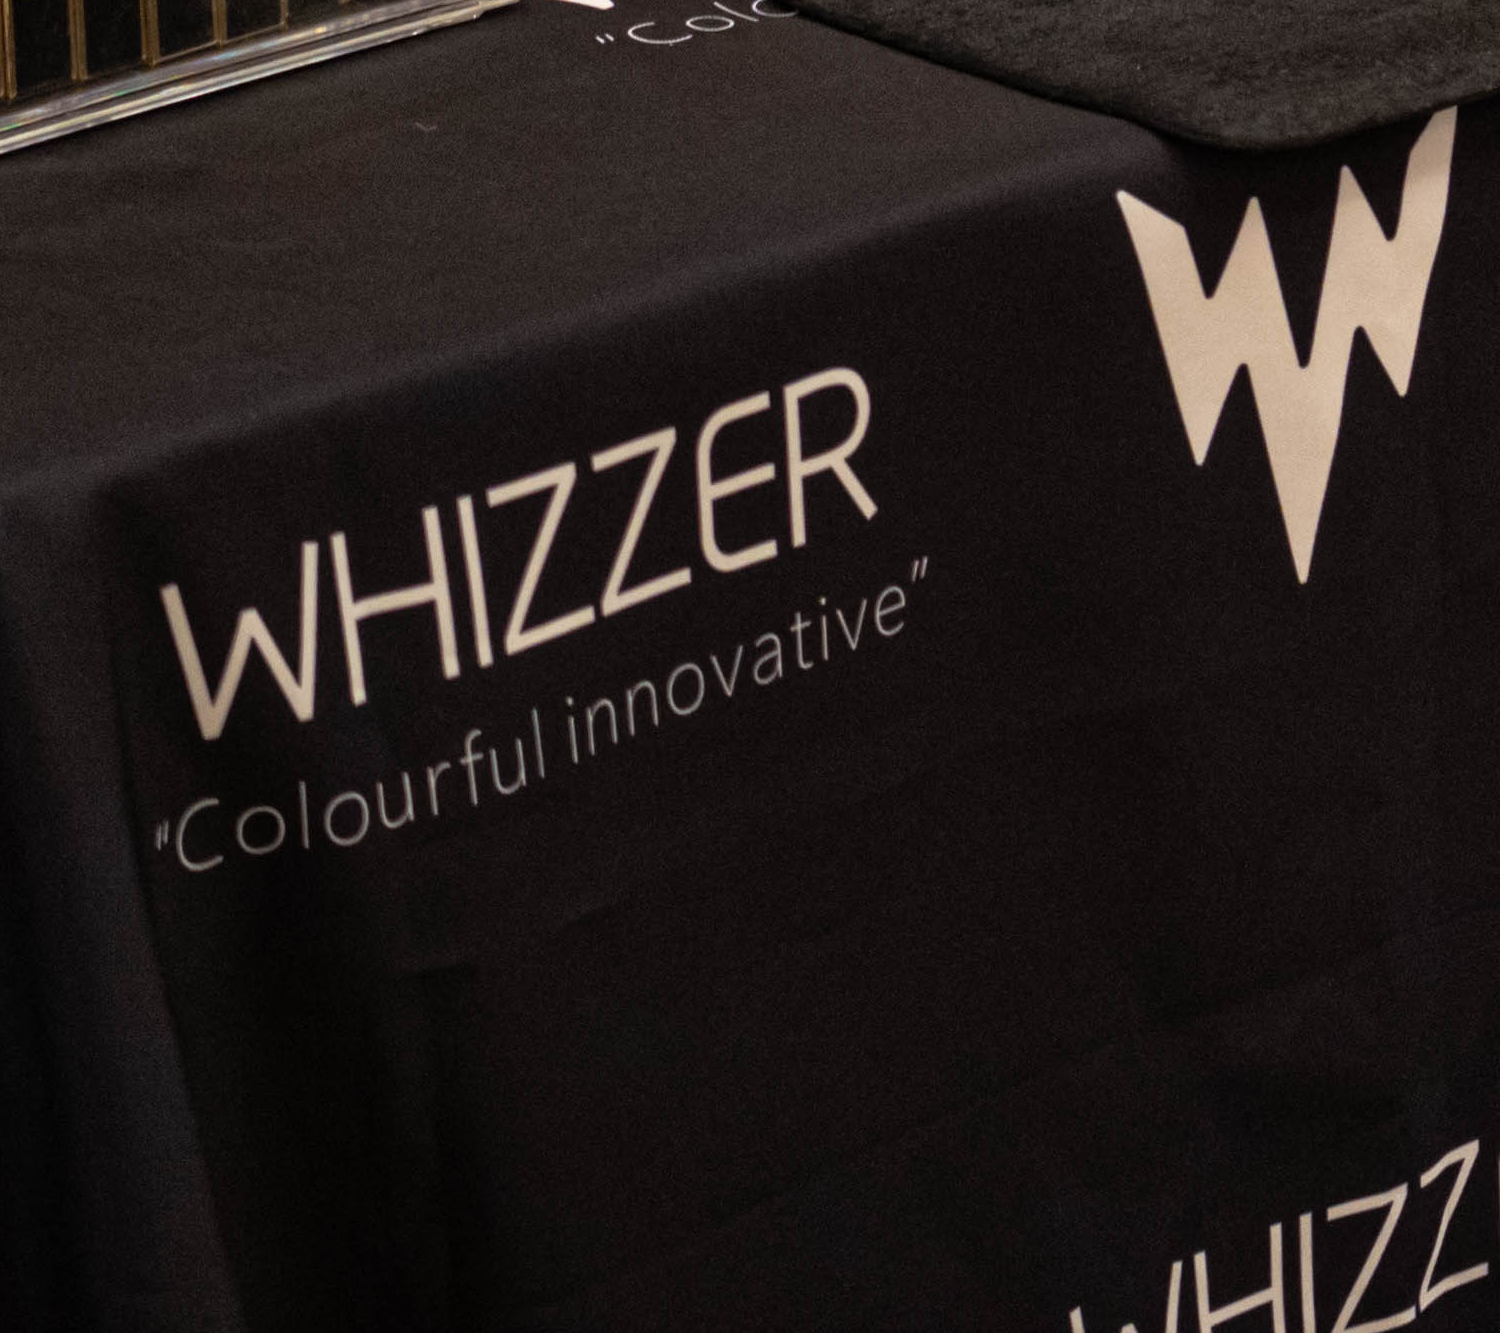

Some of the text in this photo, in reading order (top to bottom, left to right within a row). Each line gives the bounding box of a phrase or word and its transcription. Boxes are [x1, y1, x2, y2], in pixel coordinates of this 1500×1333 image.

[155, 557, 928, 870] "Colourful innovative"
[160, 367, 877, 741] WHIZZER
